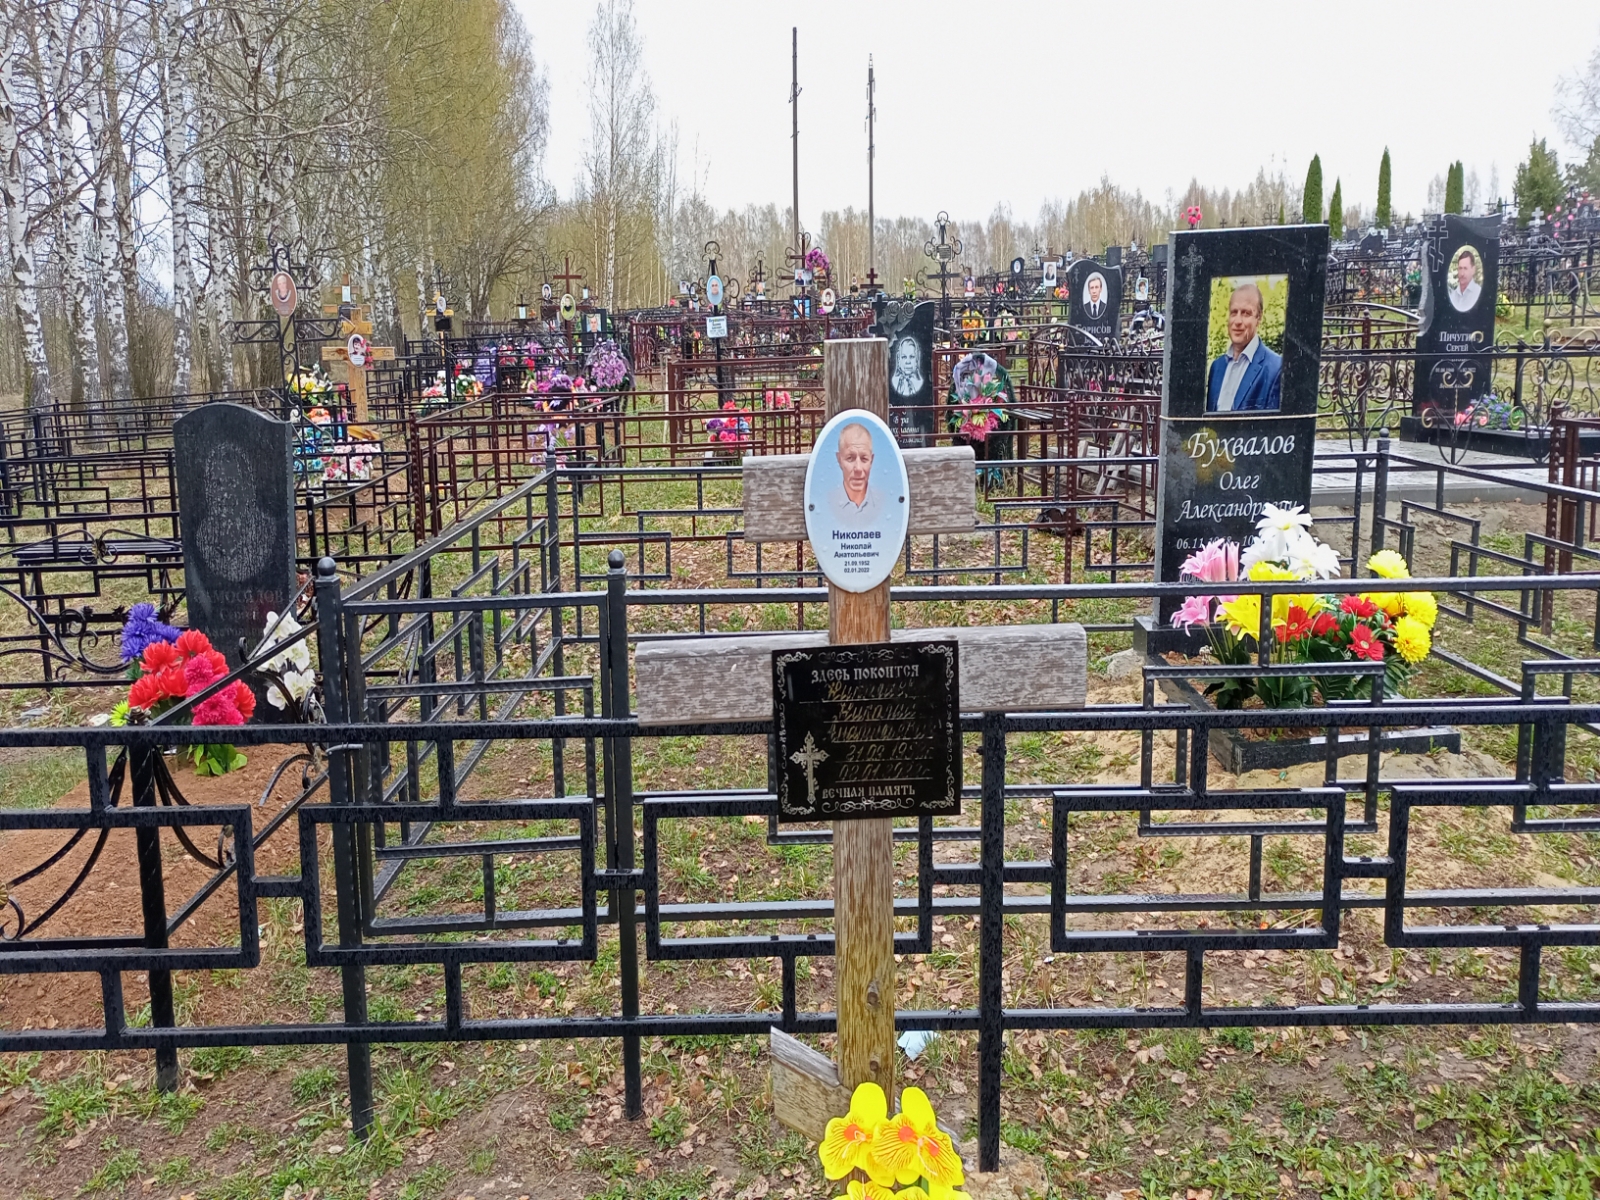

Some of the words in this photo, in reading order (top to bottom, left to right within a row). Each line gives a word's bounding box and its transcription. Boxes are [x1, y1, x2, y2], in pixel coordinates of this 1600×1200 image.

[1187, 431, 1295, 468] Бухвалов
[1219, 471, 1260, 491] Олег
[1174, 494, 1297, 523] Александри
[832, 529, 881, 540] Николаев
[840, 542, 872, 550] Николай
[834, 551, 879, 559] Анатольевич
[811, 668, 850, 683] ЗДЕСЬ
[822, 786, 865, 799] ВЕЧНАЯ
[868, 784, 916, 797] ПАМЯТЬ
